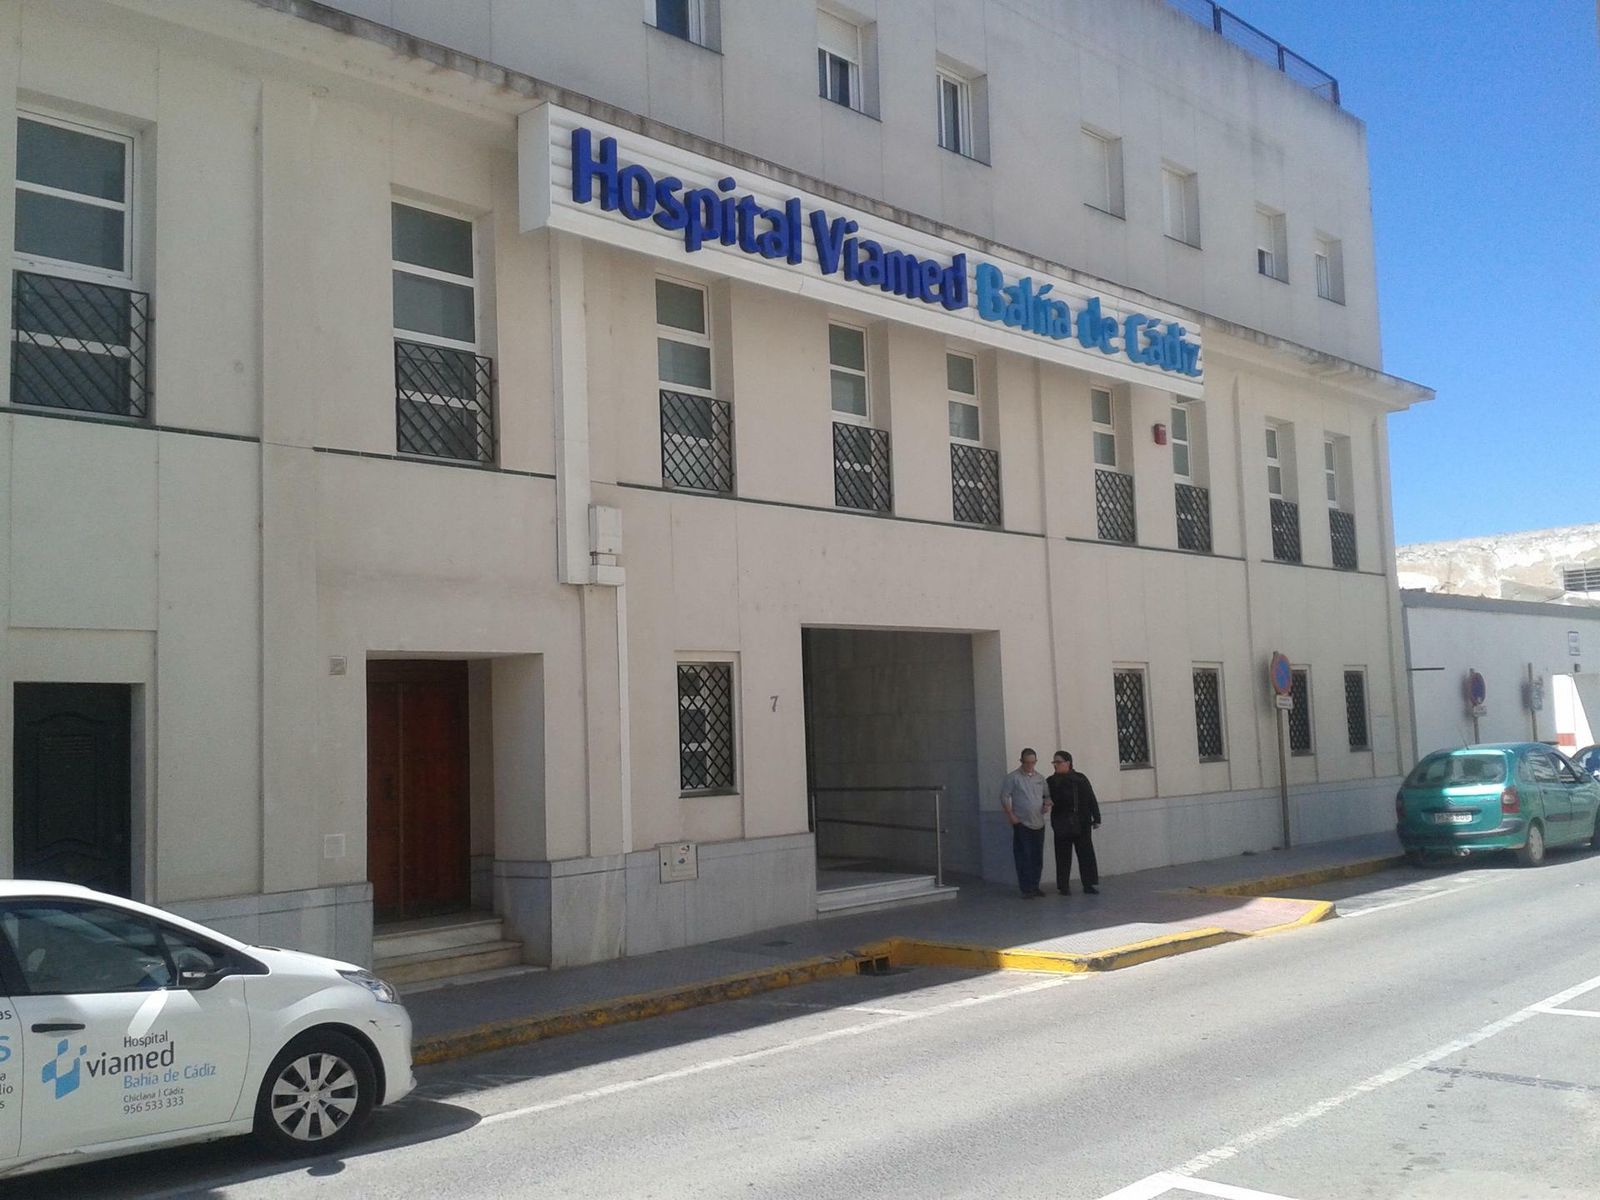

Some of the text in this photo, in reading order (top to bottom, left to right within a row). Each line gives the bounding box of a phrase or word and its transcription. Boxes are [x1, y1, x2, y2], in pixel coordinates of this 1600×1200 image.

[571, 127, 1203, 378] Hospital Viamed Bahía de Cádiz
[770, 695, 778, 712] 7
[123, 1030, 169, 1048] Hospital
[86, 1041, 175, 1078] viamed
[123, 1063, 217, 1089] Bahía de Cádiz
[123, 1091, 156, 1103] Chiclana
[123, 1096, 184, 1115] 956 533 333
